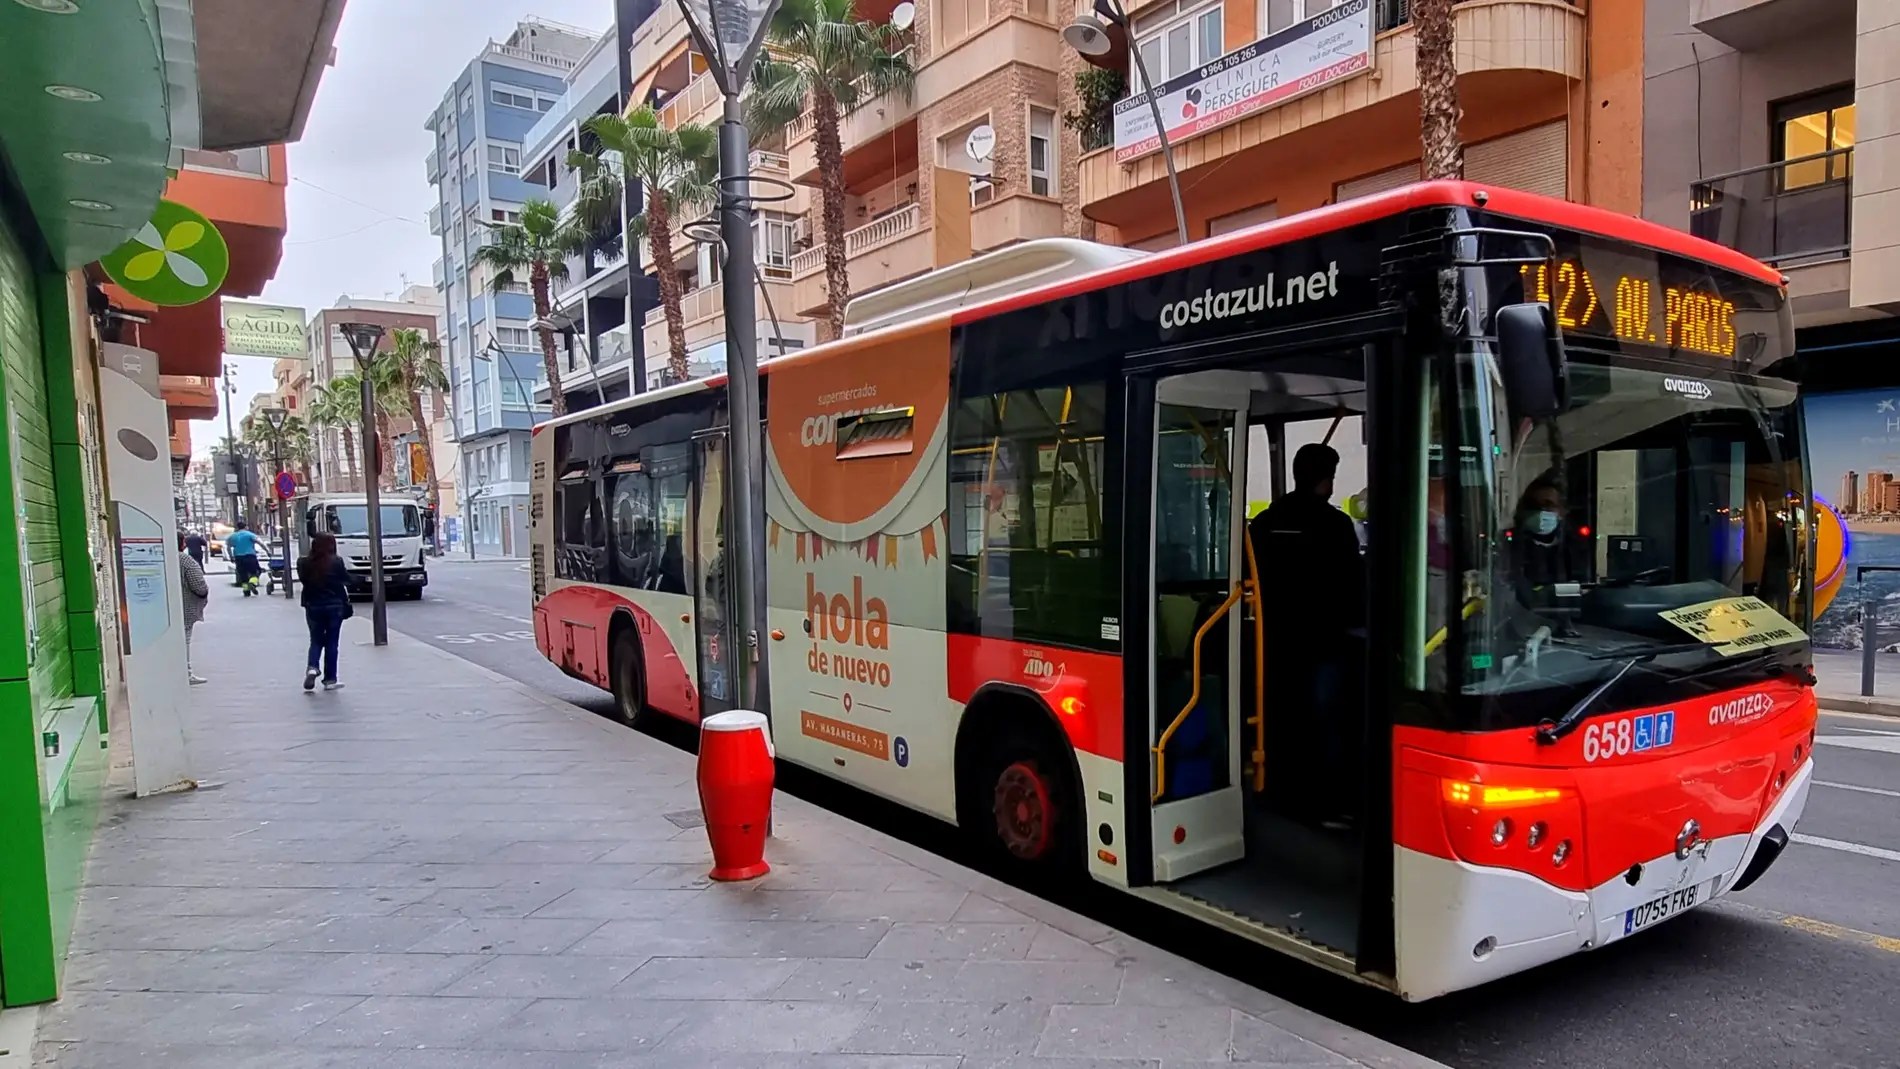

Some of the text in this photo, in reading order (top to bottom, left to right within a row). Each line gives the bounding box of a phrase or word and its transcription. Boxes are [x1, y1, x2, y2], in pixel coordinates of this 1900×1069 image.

[1207, 46, 1257, 75] 966 705 265
[1298, 57, 1364, 90] FOOT DOCTOR
[1204, 72, 1279, 114] PERSEGUER
[1117, 147, 1133, 160] SKIN
[1160, 261, 1339, 330] costazul.net
[226, 317, 304, 336] CAGIDA
[1616, 276, 1656, 342] AV.
[1665, 287, 1736, 356] PARIS
[818, 382, 877, 408] supermercados
[1664, 377, 1703, 394] avanza
[806, 572, 888, 650] hola
[808, 642, 891, 688] de nuevo
[805, 718, 818, 733] AV.
[1709, 693, 1763, 726] avanza
[1583, 718, 1632, 762] 658
[1635, 885, 1697, 928] 0755 FKB
